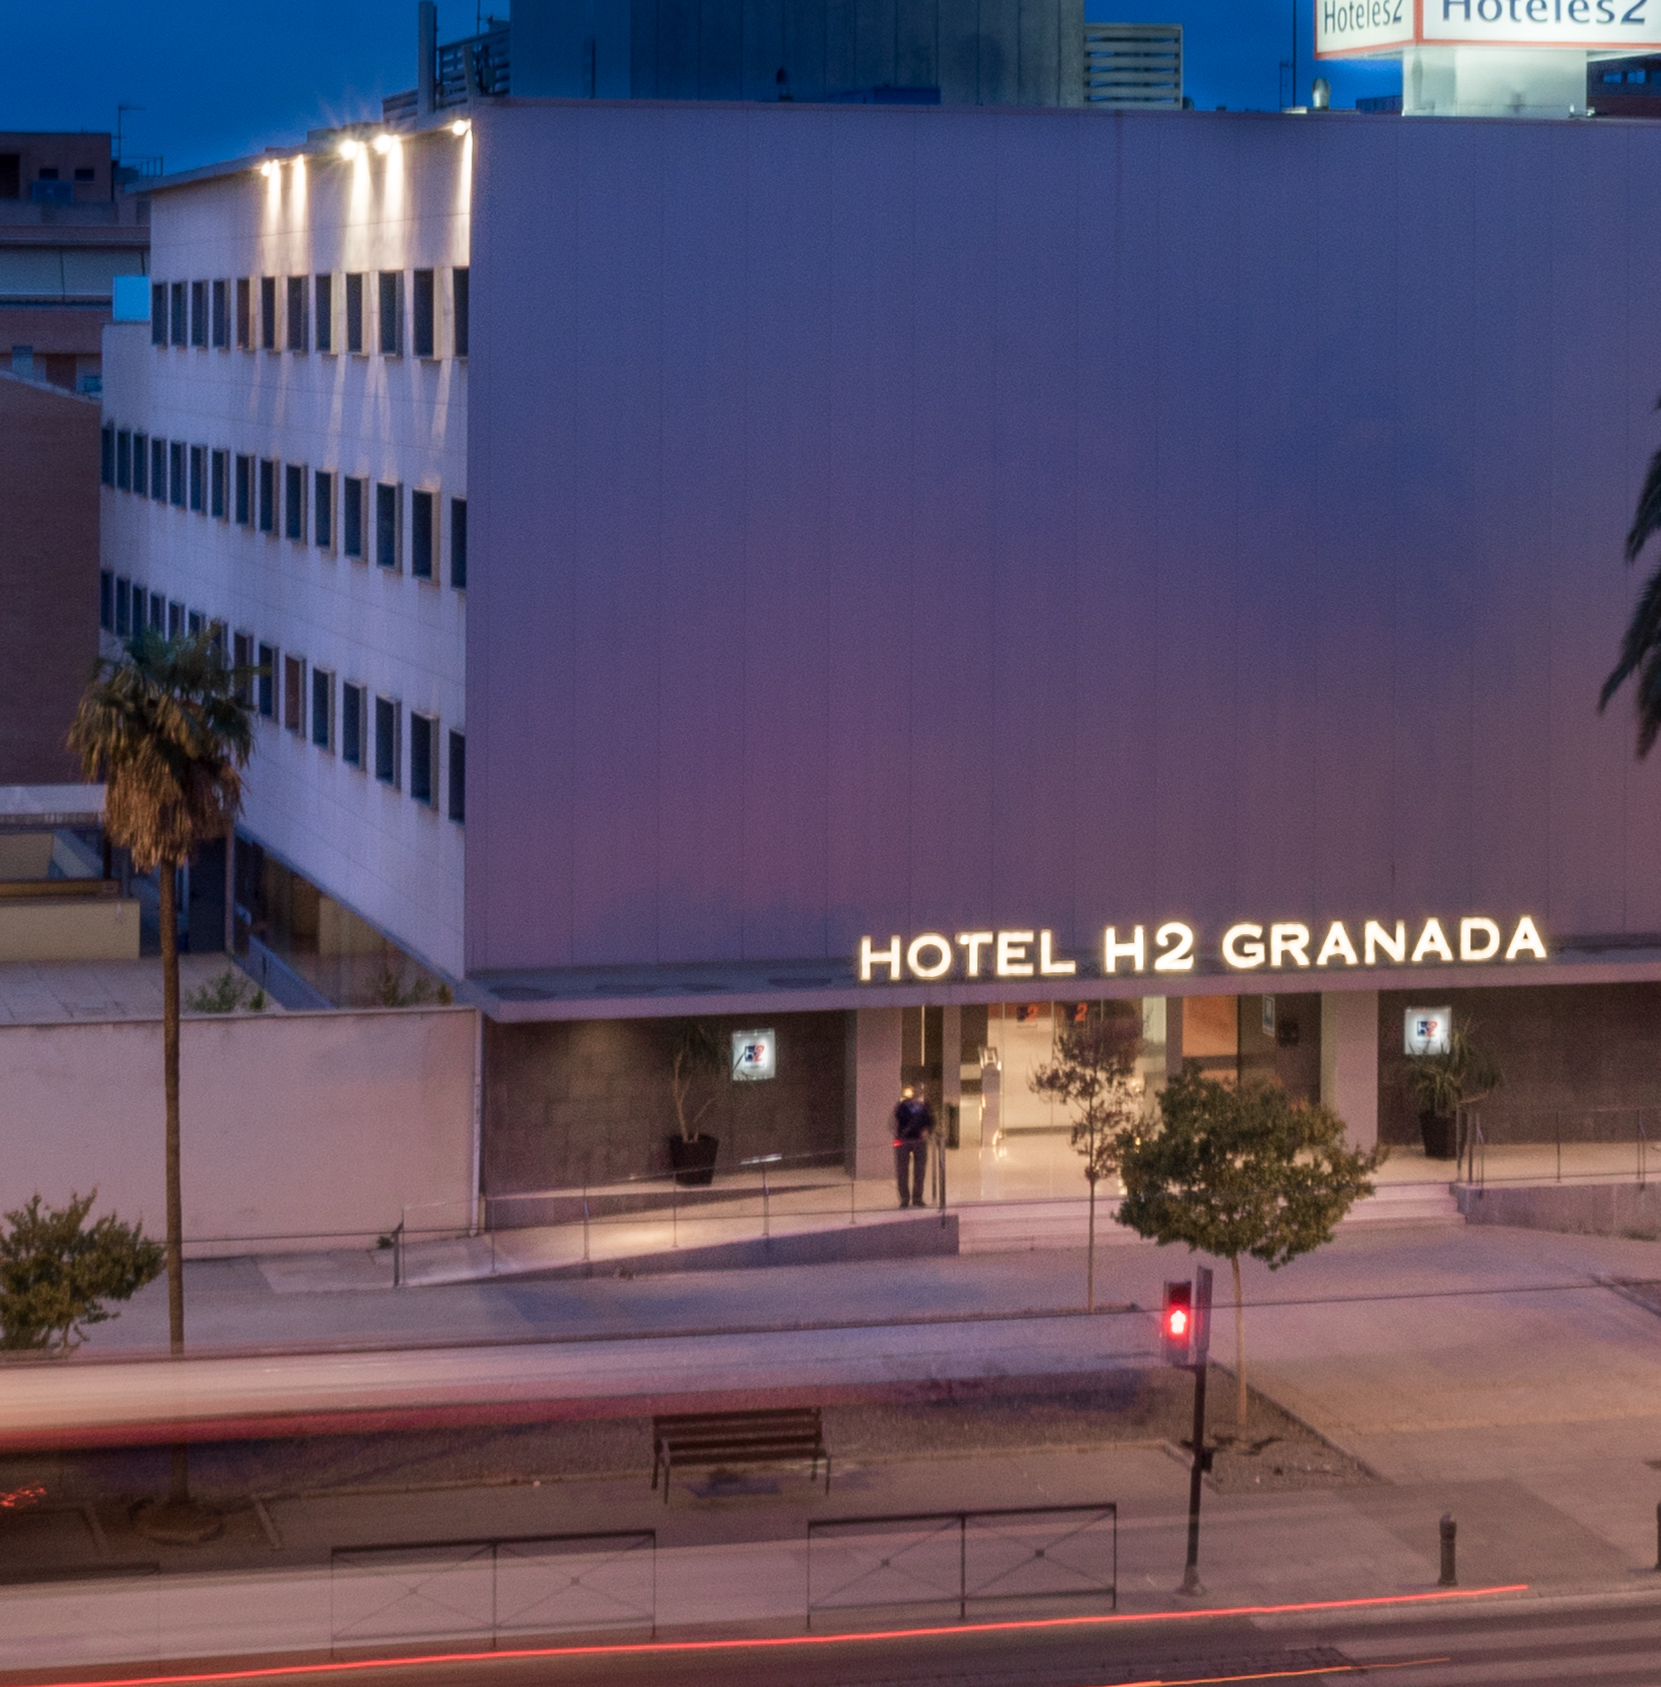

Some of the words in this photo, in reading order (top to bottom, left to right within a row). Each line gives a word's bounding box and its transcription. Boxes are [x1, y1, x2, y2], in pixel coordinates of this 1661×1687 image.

[859, 930, 1078, 981] HOTEL
[1103, 922, 1196, 974] H2
[1221, 914, 1550, 969] GRANADA
